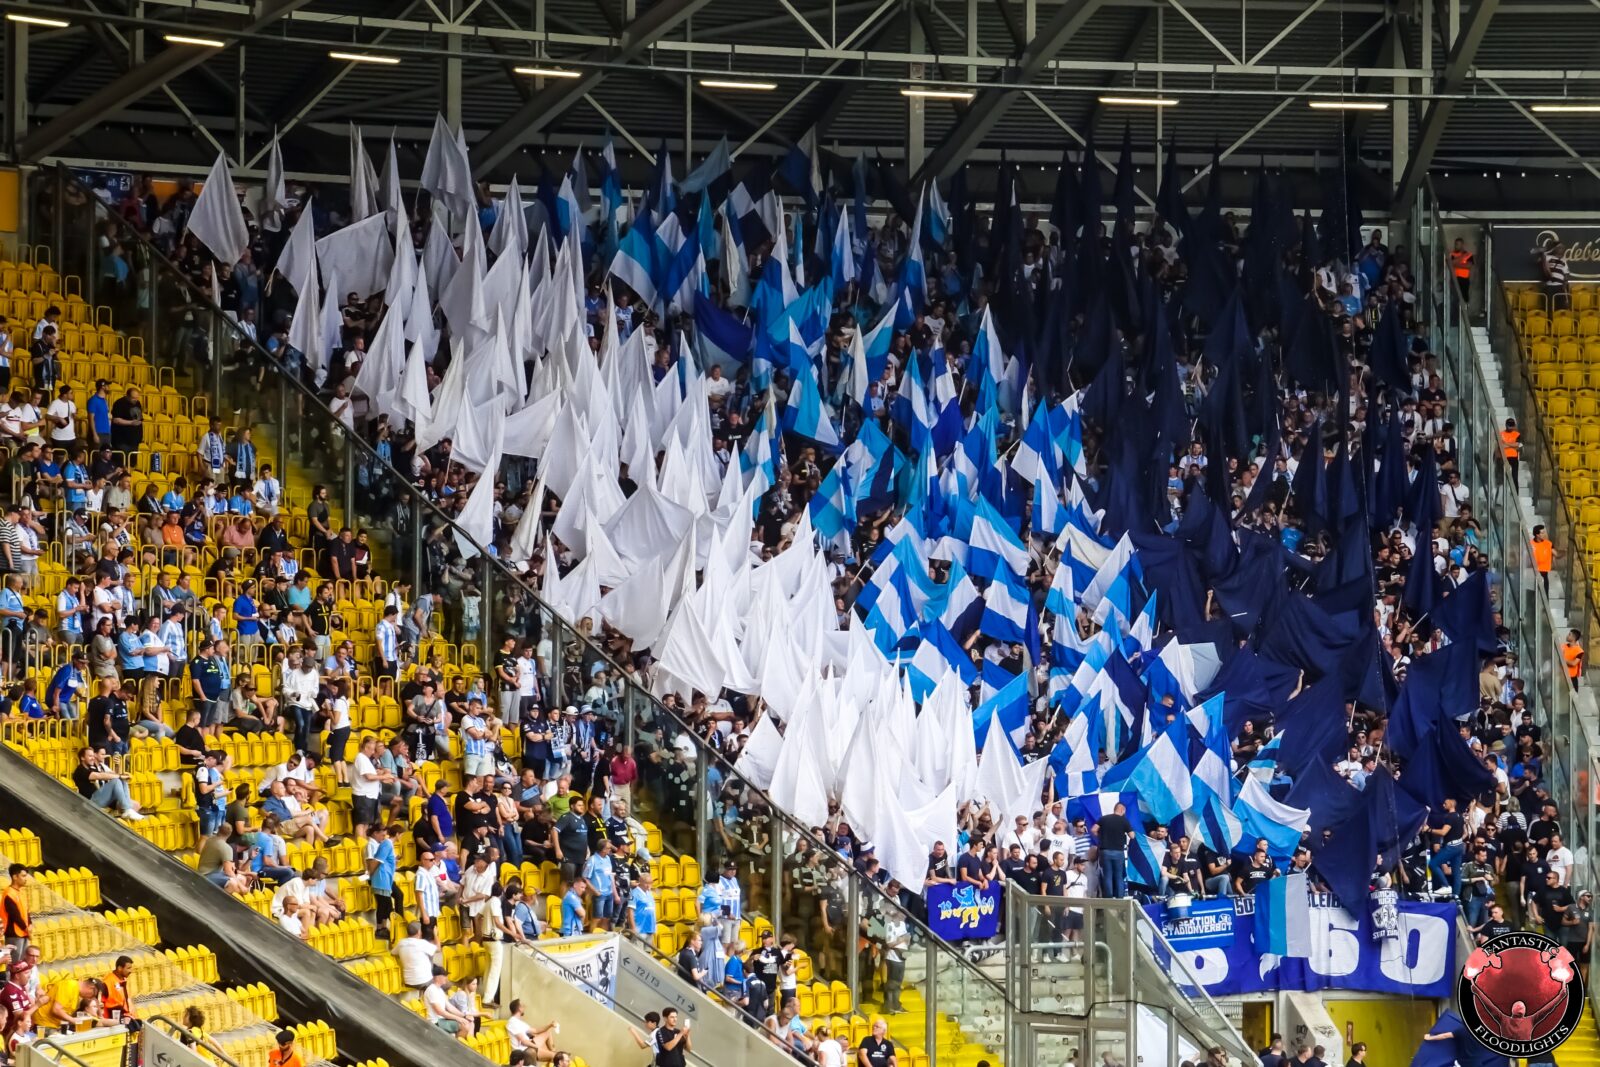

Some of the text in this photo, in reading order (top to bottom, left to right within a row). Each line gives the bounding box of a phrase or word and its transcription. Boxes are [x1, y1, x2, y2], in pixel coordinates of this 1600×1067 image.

[1162, 921, 1233, 937] STADIONVERBOT
[636, 966, 646, 977] T2
[650, 976, 660, 988] T3
[676, 994, 686, 1006] T1
